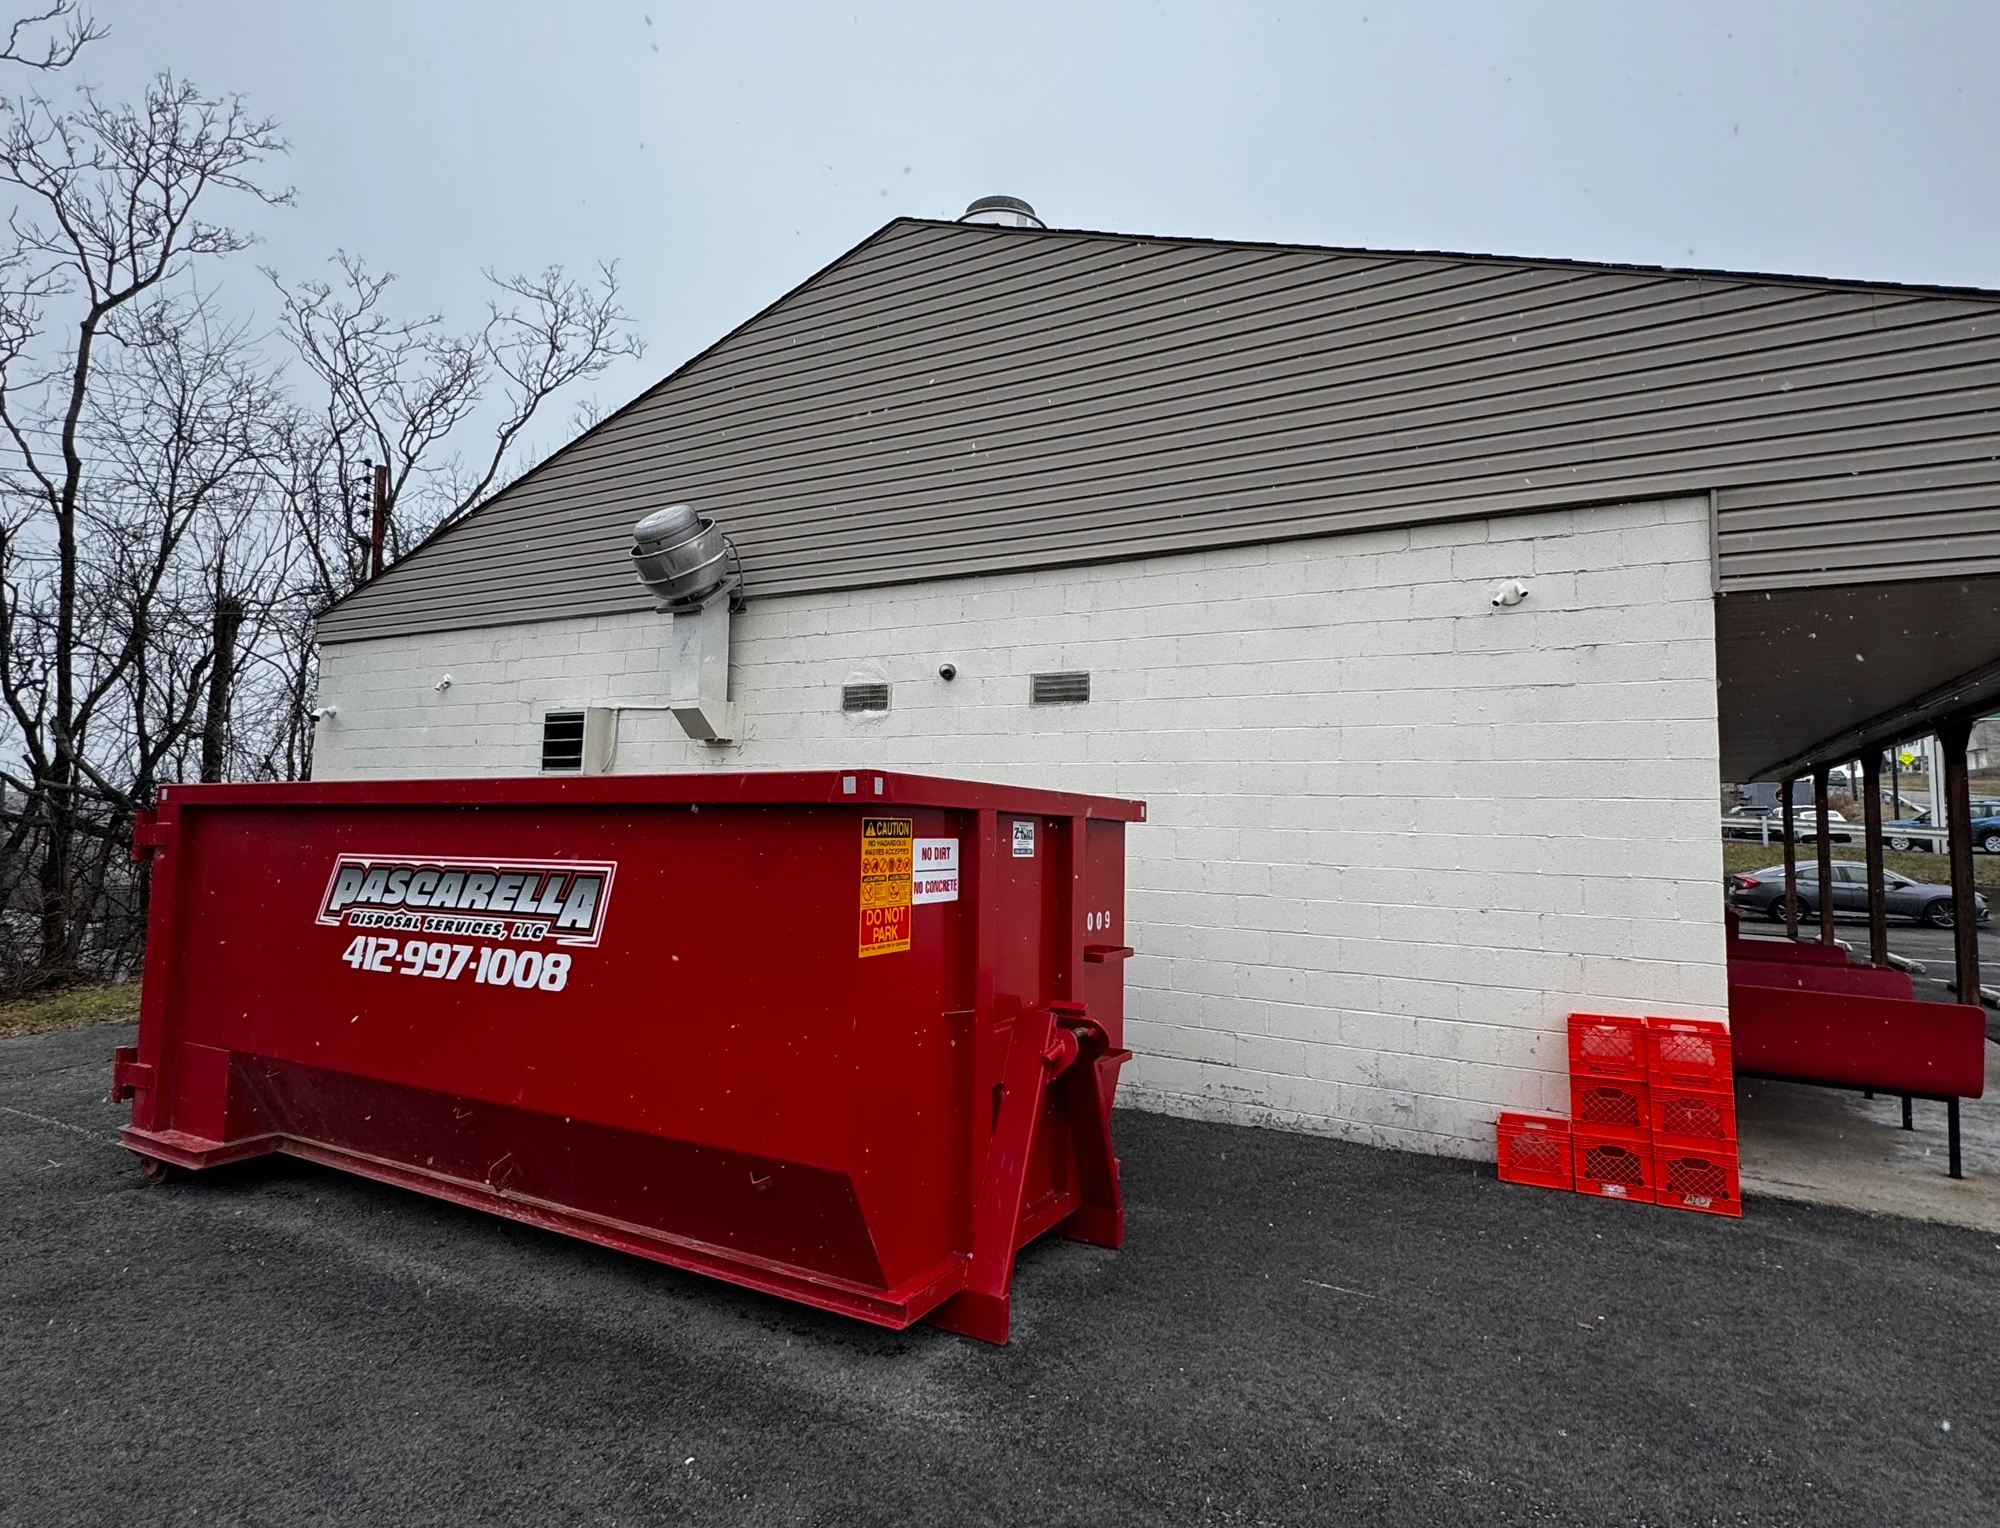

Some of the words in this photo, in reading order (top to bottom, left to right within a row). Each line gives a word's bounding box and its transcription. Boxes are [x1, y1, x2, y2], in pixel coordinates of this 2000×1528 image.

[876, 821, 910, 836] CAUTION
[885, 848, 910, 856] ACCEPTED
[922, 847, 932, 861] NO
[934, 847, 951, 860] DIRT
[913, 881, 924, 894] NO
[925, 879, 957, 893] CONCRETE
[328, 868, 601, 929] PASCARELLA
[866, 909, 882, 926] DO
[884, 906, 906, 924] NOT
[349, 913, 422, 930] DISPOSAL
[424, 917, 509, 940] SERVICES,
[511, 924, 546, 940] LLC
[872, 925, 899, 943] PARK
